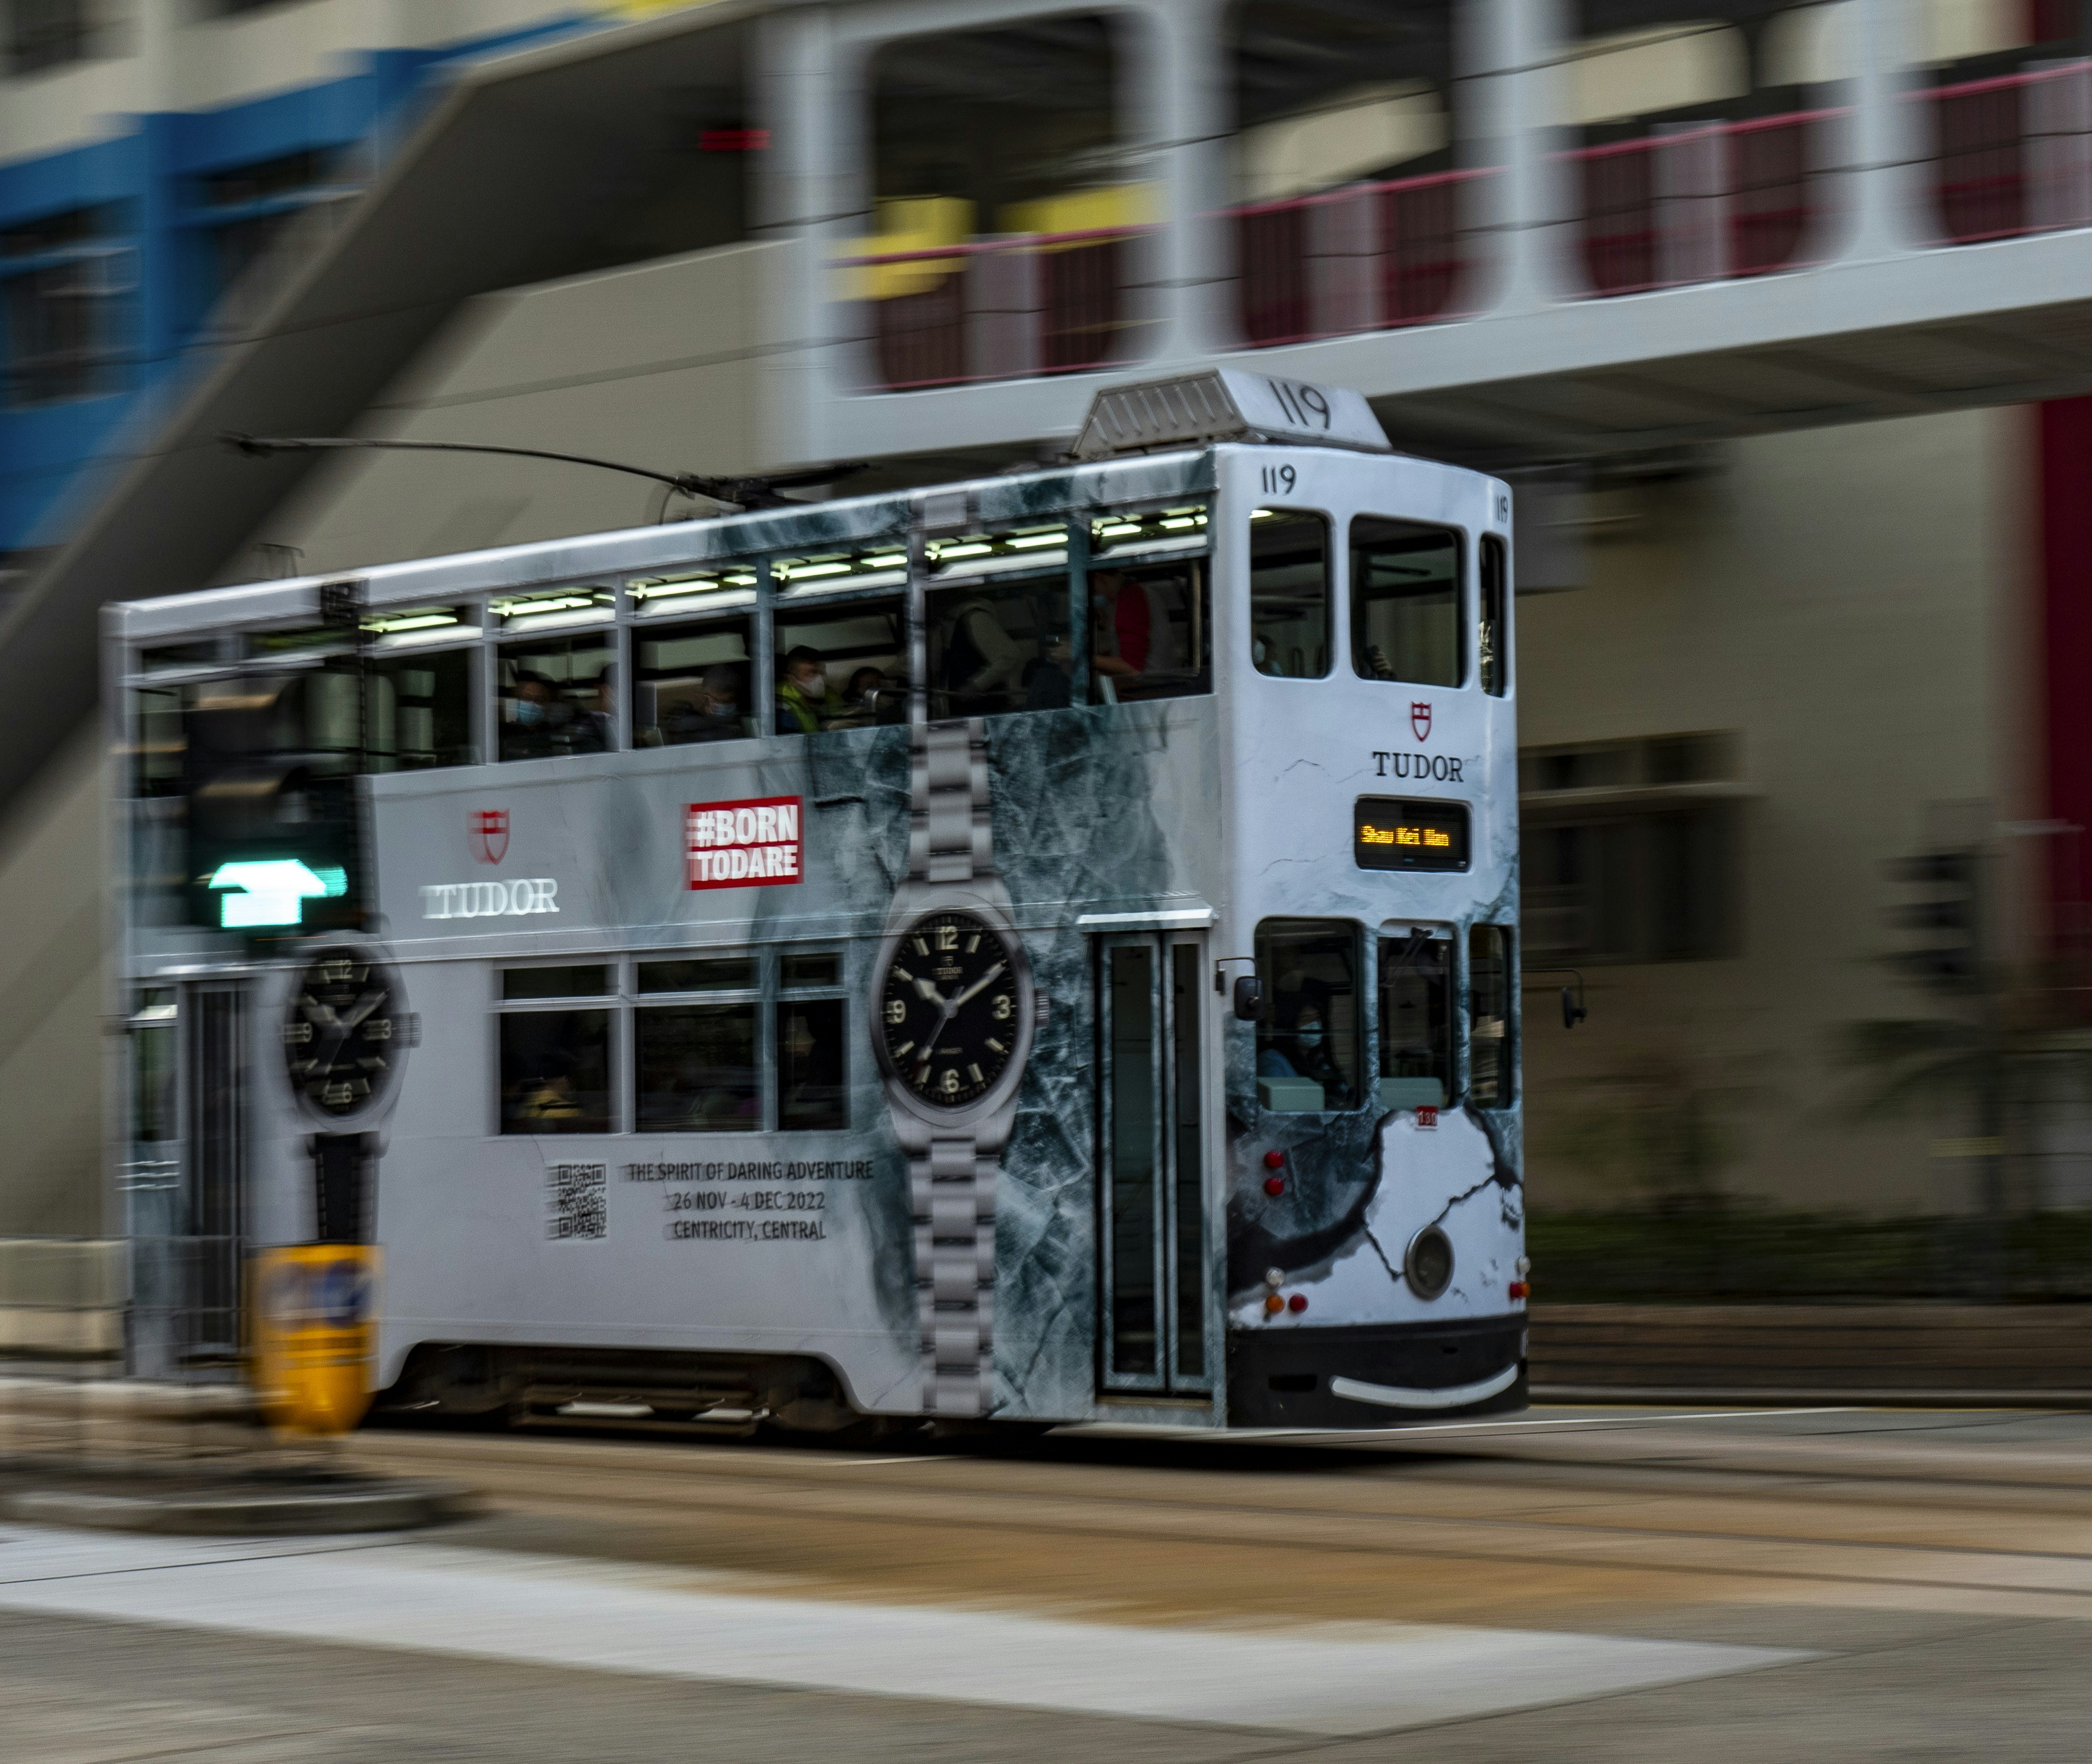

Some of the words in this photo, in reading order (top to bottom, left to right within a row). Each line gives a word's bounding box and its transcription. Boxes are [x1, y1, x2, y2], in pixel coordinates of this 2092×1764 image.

[1269, 379, 1331, 430] 119
[1262, 464, 1296, 495] 119
[1495, 495, 1508, 524] 119
[1373, 751, 1464, 782] TUDOR
[690, 805, 798, 847] #BORN
[690, 845, 798, 881] TODARE
[421, 878, 560, 919] TUDOR
[935, 926, 959, 950] 12
[992, 994, 1011, 1020] 3
[940, 1069, 959, 1094] 6
[627, 1163, 654, 1181] THE
[657, 1162, 702, 1181] SPIRIT
[706, 1162, 724, 1180] OF
[728, 1161, 783, 1180] DARING
[786, 1160, 874, 1180] ADVENTURE
[672, 1191, 692, 1210] 26
[697, 1191, 727, 1209] NOV
[740, 1191, 750, 1209] 4
[755, 1191, 783, 1209] DEC
[787, 1191, 825, 1209] 2022
[673, 1220, 758, 1241] CENTRICITY,
[762, 1220, 827, 1239] CENTRAL
